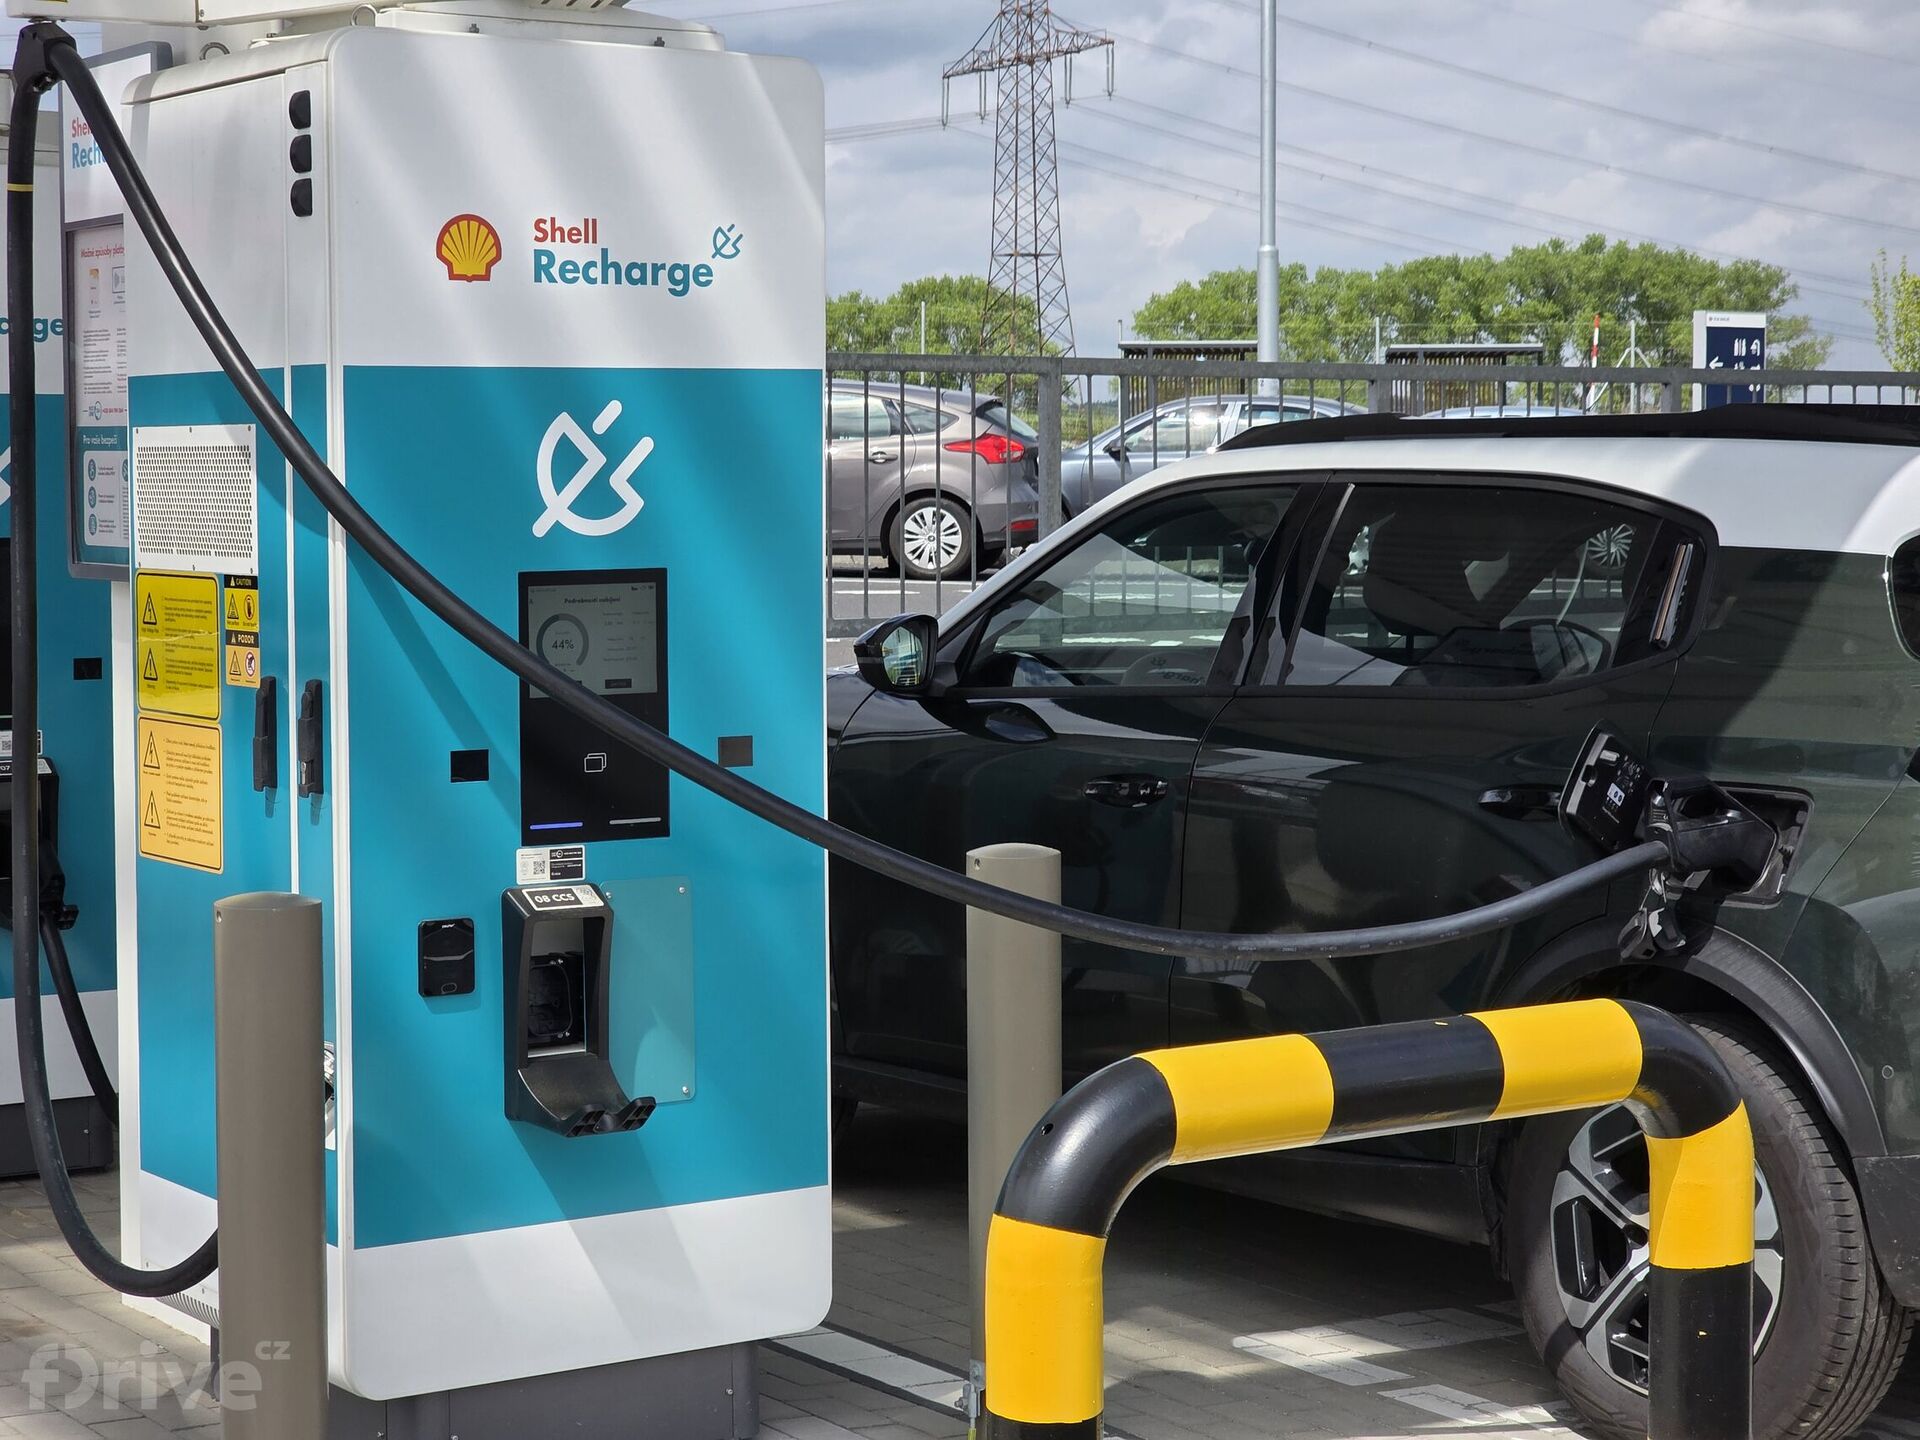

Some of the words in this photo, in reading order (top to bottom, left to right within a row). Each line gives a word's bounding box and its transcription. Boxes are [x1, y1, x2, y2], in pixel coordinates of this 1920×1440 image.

[533, 216, 598, 244] Shell
[533, 247, 714, 298] Recharge
[237, 634, 255, 645] POZOR
[552, 639, 574, 650] 44%
[534, 893, 551, 904] 08
[552, 892, 575, 902] CCS
